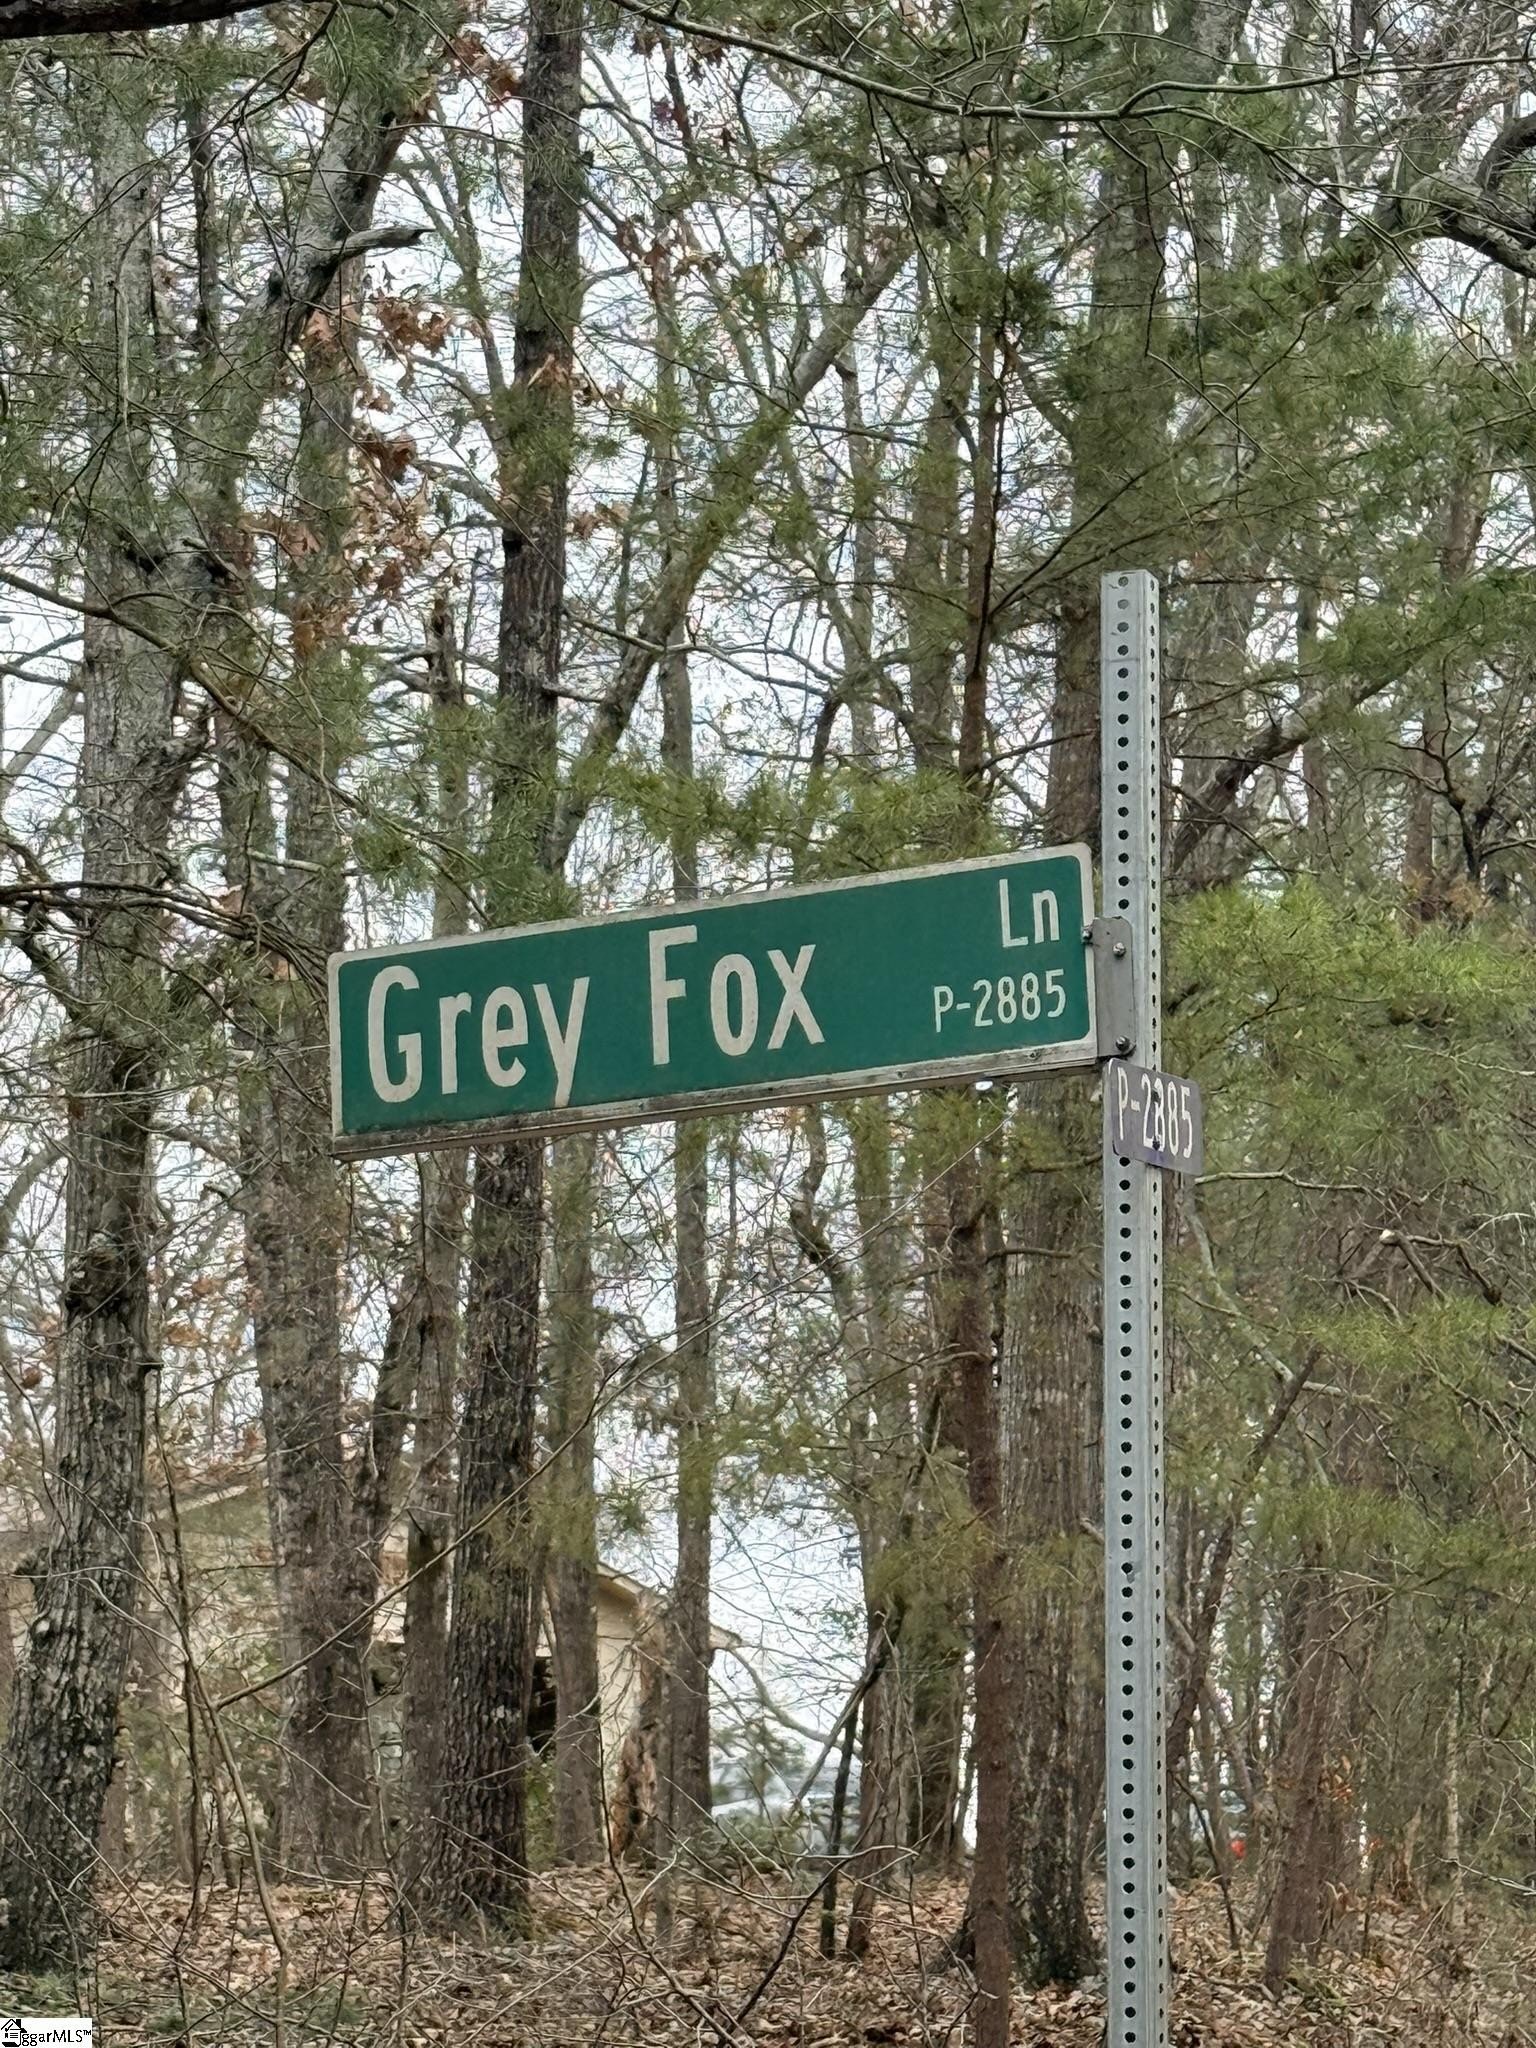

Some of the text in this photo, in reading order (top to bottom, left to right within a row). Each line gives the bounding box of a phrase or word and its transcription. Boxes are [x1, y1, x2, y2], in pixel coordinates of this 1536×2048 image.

[999, 878, 1060, 948] Ln
[368, 925, 825, 1107] Grey Fox
[934, 968, 1067, 1033] P-2885
[1117, 1066, 1194, 1158] P-2885
